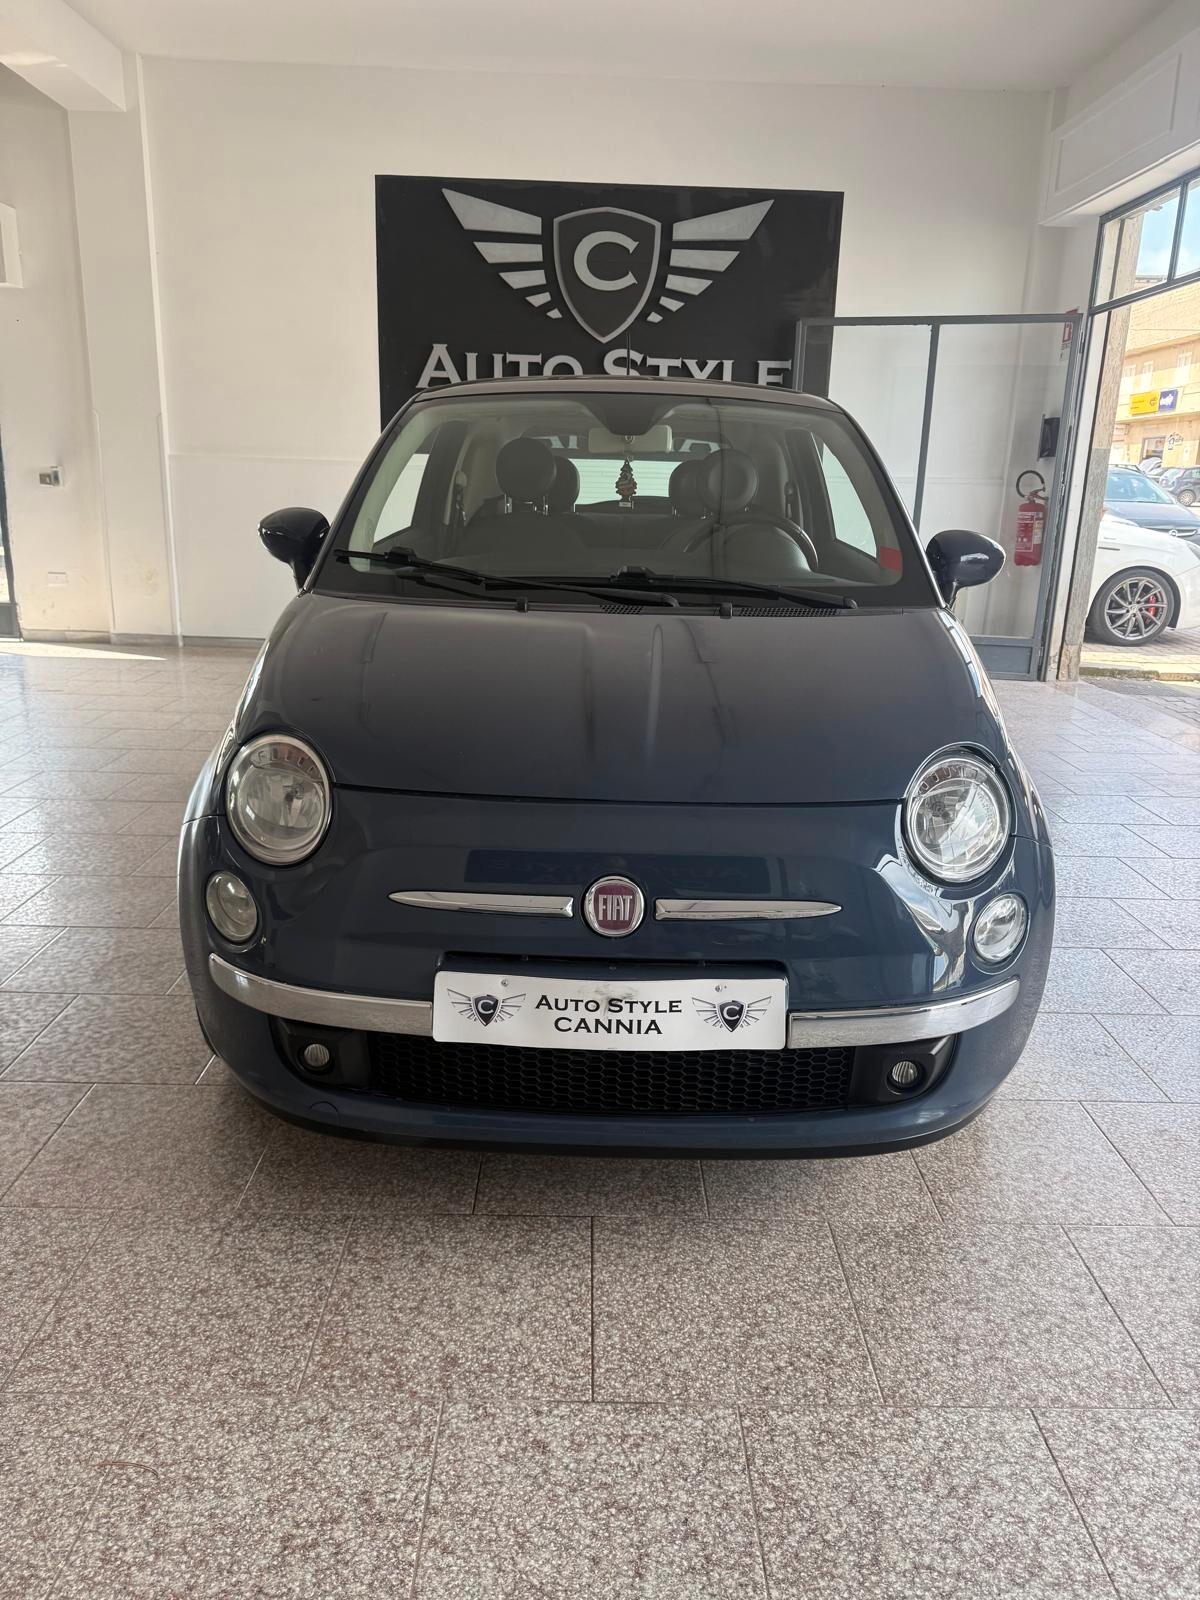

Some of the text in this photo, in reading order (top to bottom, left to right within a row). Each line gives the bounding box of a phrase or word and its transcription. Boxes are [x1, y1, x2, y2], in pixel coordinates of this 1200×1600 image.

[573, 230, 640, 291] C
[598, 894, 633, 921] FIAT
[477, 999, 495, 1015] C
[535, 994, 682, 1014] AUTO STYLE
[723, 1005, 740, 1020] C
[554, 1016, 663, 1035] CANNIA
